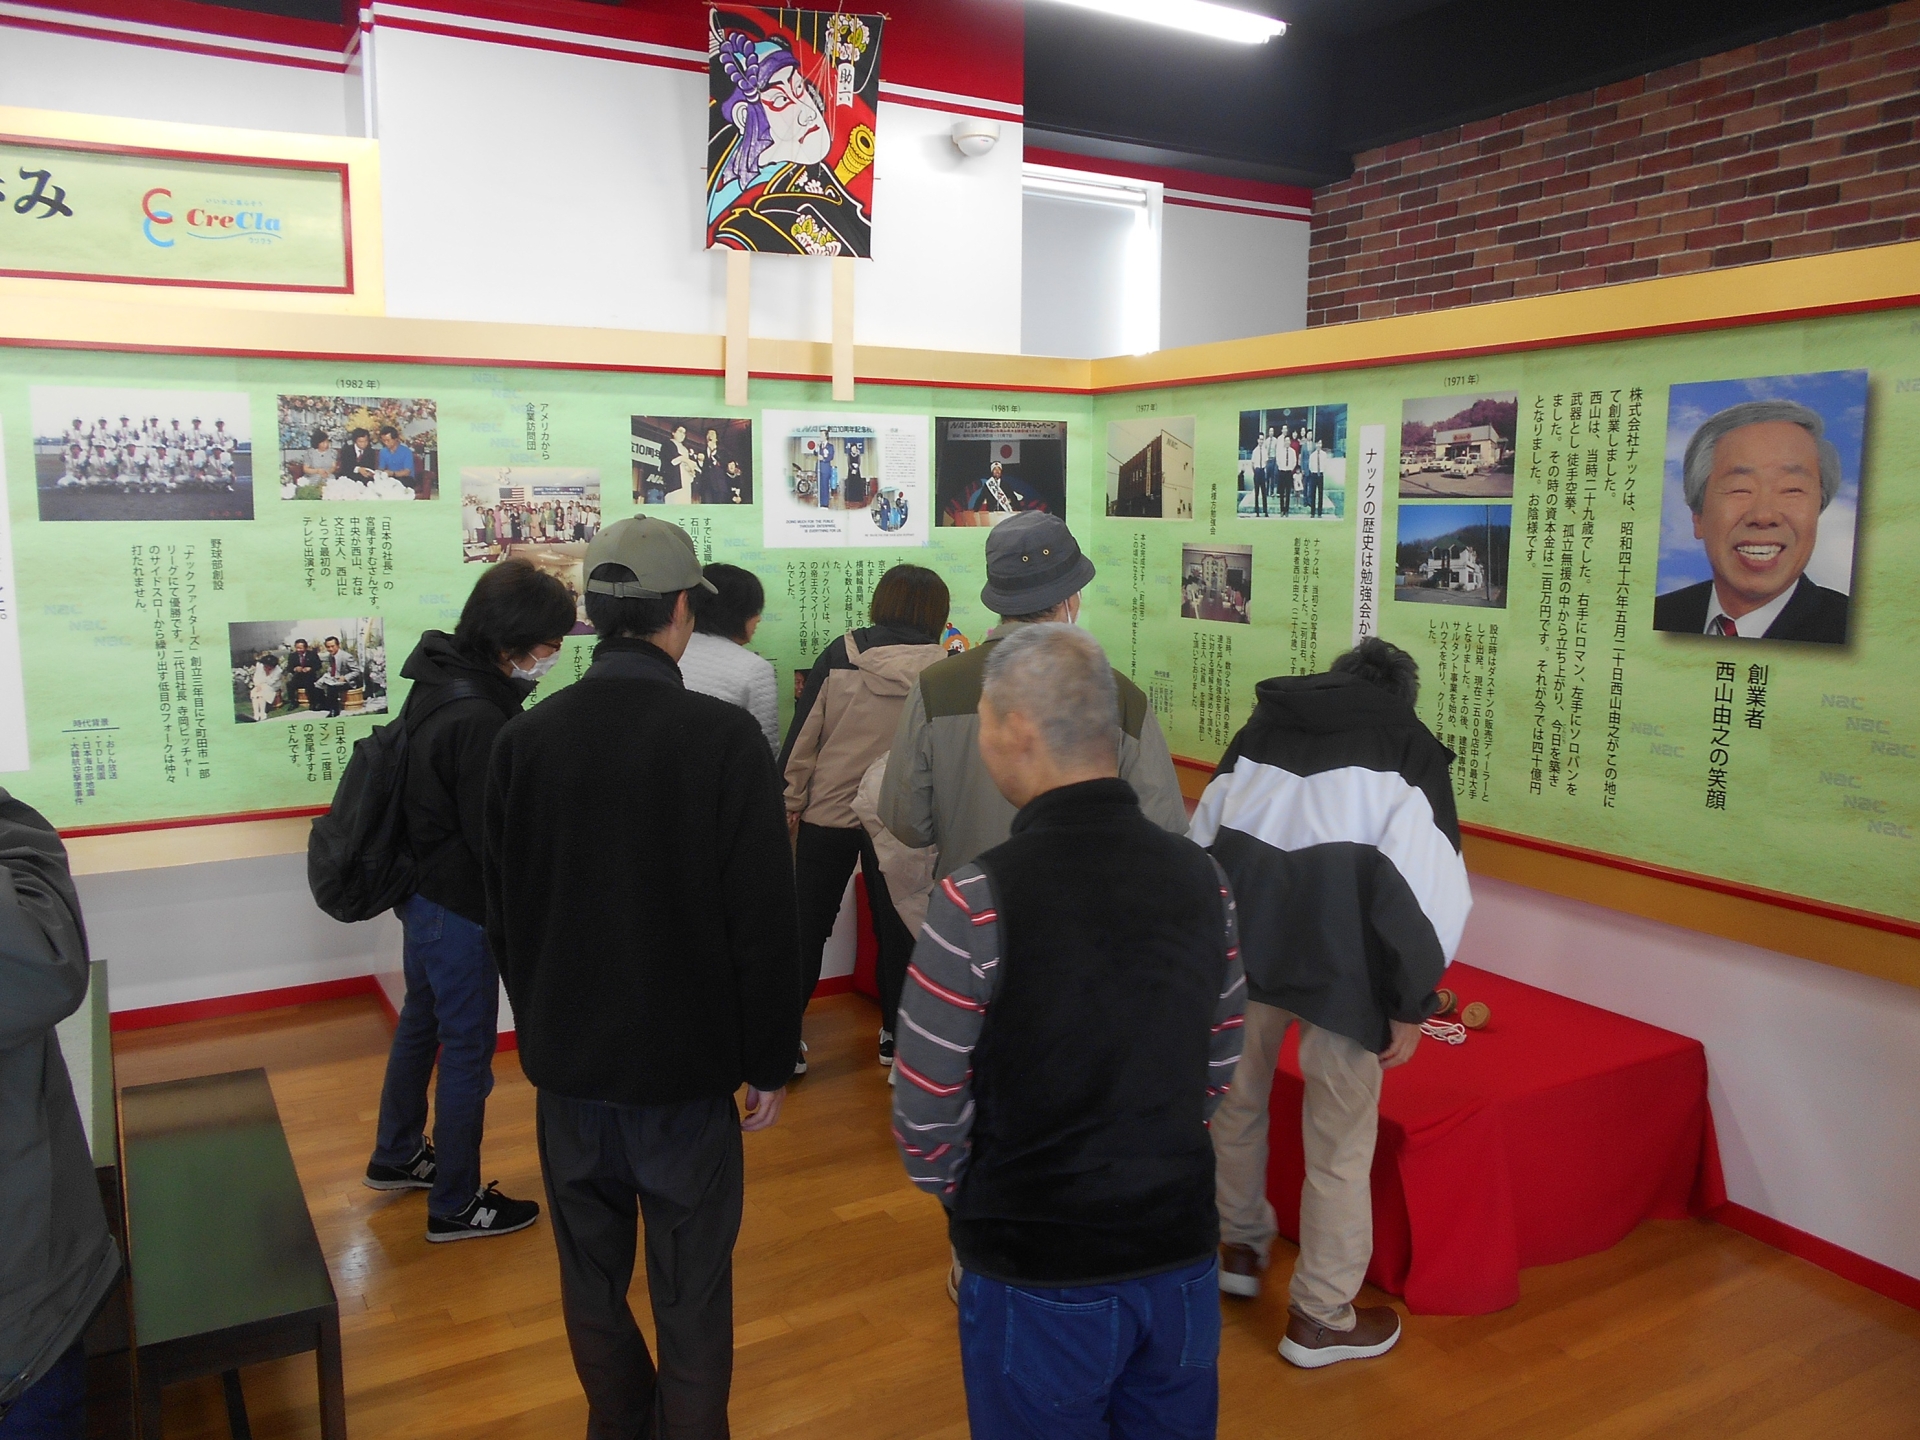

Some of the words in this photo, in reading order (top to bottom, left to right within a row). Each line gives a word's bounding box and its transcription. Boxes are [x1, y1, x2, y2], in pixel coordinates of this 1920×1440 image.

[0, 166, 73, 219] み
[186, 208, 281, 231] CreCla
[526, 402, 536, 451] 企業訪問団
[540, 403, 551, 460] アメリカから
[1604, 389, 1622, 498] て創業しました。
[1525, 395, 1544, 568] となりました。お陰様です。
[210, 538, 224, 591] 野球部創設
[303, 516, 316, 592] テレビ出演です。
[319, 517, 331, 577] とって最初の
[334, 517, 348, 597] 文江夫人、西山に
[350, 517, 363, 596] 中央が西山、右は
[365, 516, 379, 610] 宮尾すすむさんです。
[381, 516, 394, 591] 「日本の社長」の
[703, 517, 713, 566] すでに退職
[1358, 448, 1378, 644] ナックの歴史は勉強会か
[131, 544, 147, 613] 打たれません。
[787, 561, 796, 600] んでした。
[799, 561, 808, 656] スカイライナーズの皆さ
[810, 561, 819, 655] の帝王スマイリー小原と
[844, 560, 853, 632] 人も数人お越し頂
[1530, 393, 1564, 795] ました。その時の資本金は二百万円です。それが今では四十億円
[1566, 390, 1603, 796] 西山は、当時二十九歳でした。右手にロマン、左手にソロバンを
[1603, 387, 1643, 808] 株式会社ナックは、昭和四十六年五月二十日西山由之がこの地に
[149, 545, 176, 784] のサイドスローから繰り出す低目のフォークは仲々
[1428, 619, 1437, 644] した。
[73, 718, 109, 728] 時代背景
[1744, 664, 1769, 730] 創業者
[287, 724, 300, 767] さんです。
[304, 723, 316, 782] の宮尾すすむ
[319, 722, 332, 781] マン」二度目
[1705, 661, 1736, 811] 西山由之の笑顔
[470, 1207, 497, 1228] N
